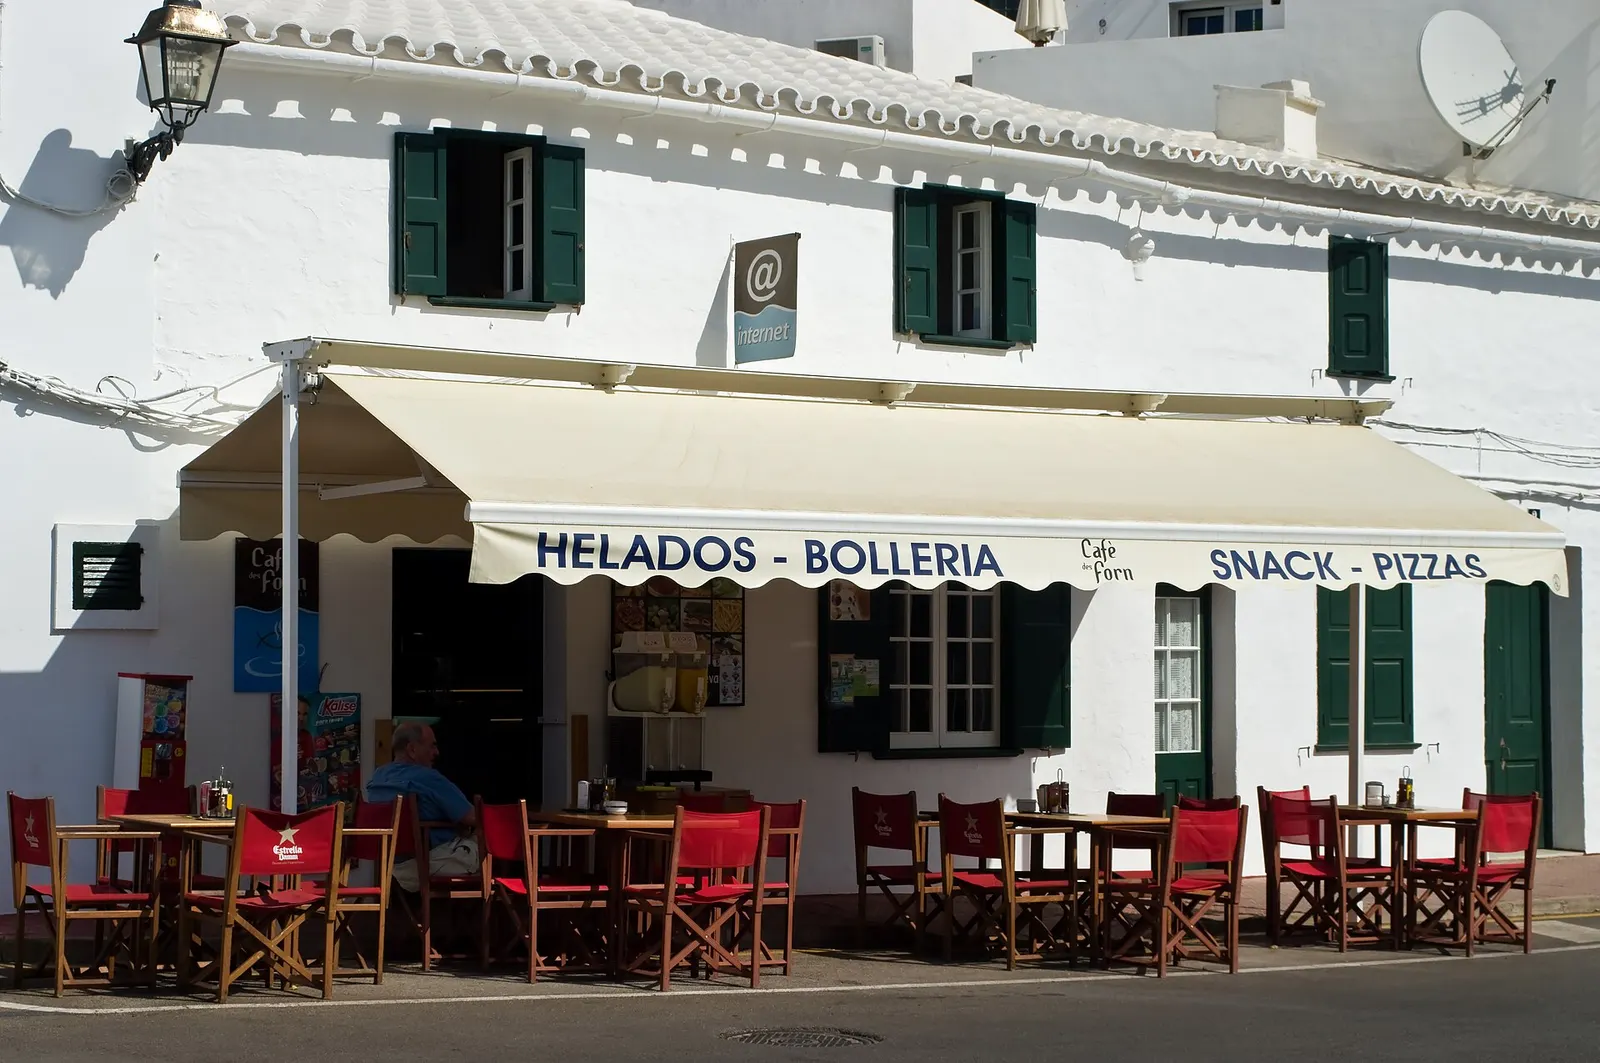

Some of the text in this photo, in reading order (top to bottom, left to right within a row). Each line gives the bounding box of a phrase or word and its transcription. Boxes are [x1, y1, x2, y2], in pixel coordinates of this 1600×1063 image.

[747, 249, 782, 302] @
[738, 323, 790, 346] internet
[537, 532, 757, 572] HELADOS
[805, 540, 1004, 577] BOLLERIA
[1210, 549, 1341, 580] SNACK
[1372, 552, 1487, 580] PIZZAS
[324, 698, 356, 716] Kalise
[273, 845, 303, 855] Estrella
